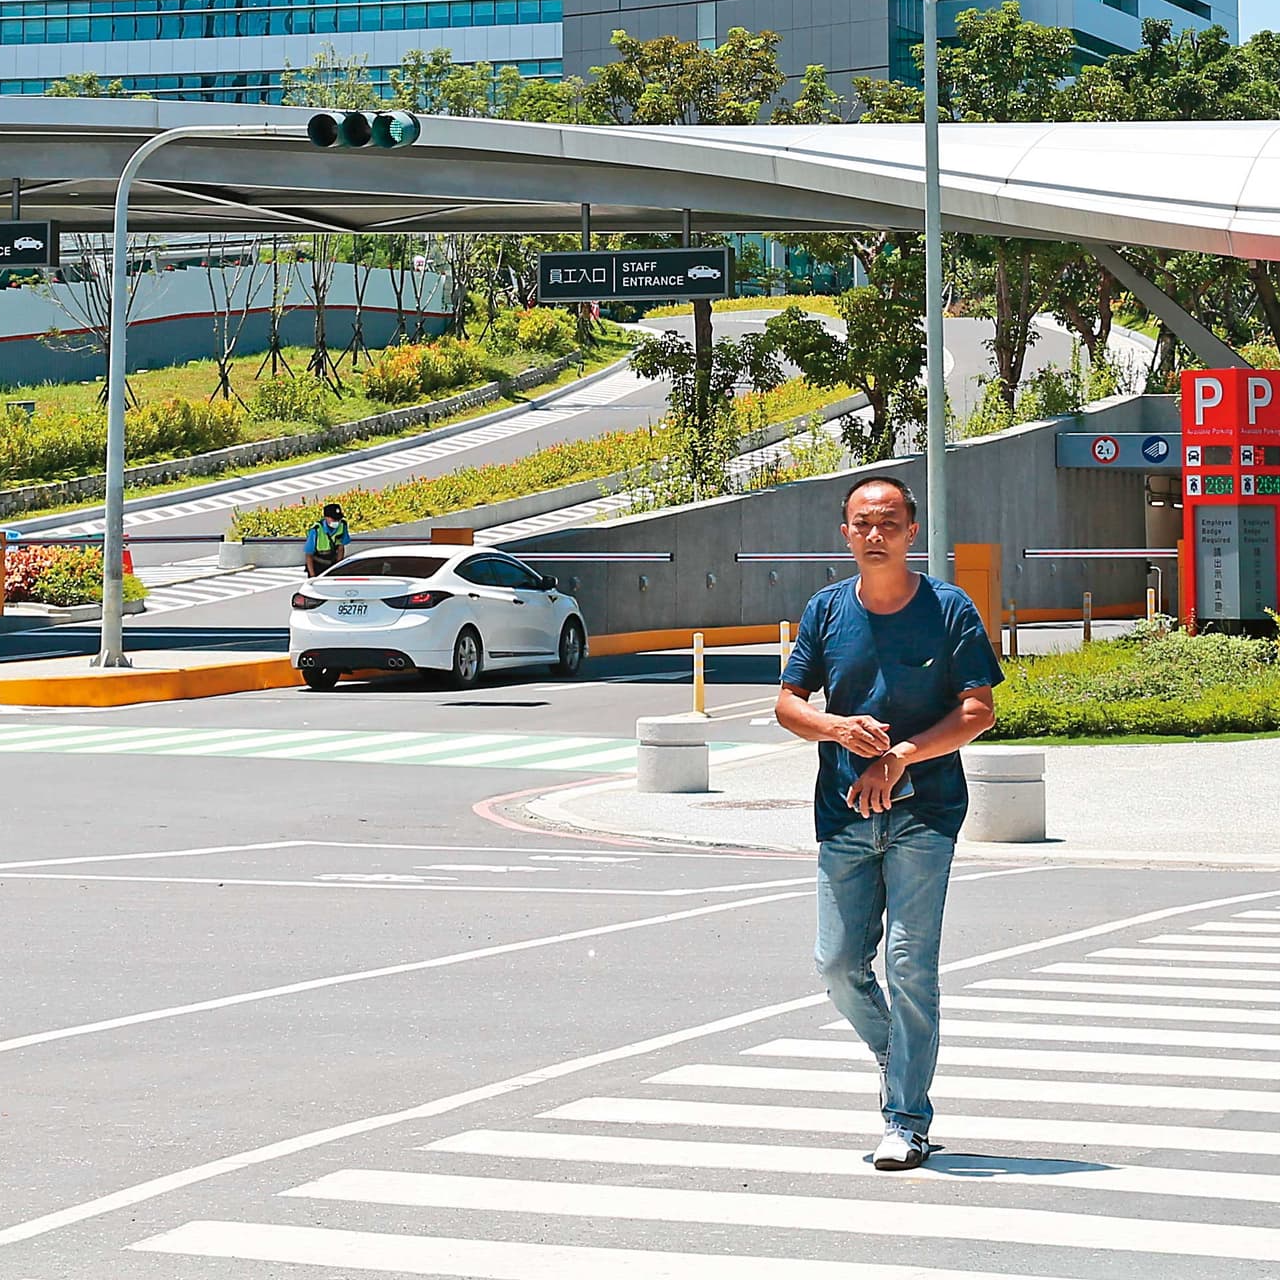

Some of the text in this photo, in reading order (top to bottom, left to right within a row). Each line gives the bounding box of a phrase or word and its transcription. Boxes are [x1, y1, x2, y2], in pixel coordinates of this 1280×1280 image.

[622, 261, 658, 272] STAFF
[549, 268, 607, 285] 員工入口
[622, 275, 685, 287] ENTRANCE
[1195, 377, 1223, 426] P
[1247, 377, 1272, 425] P
